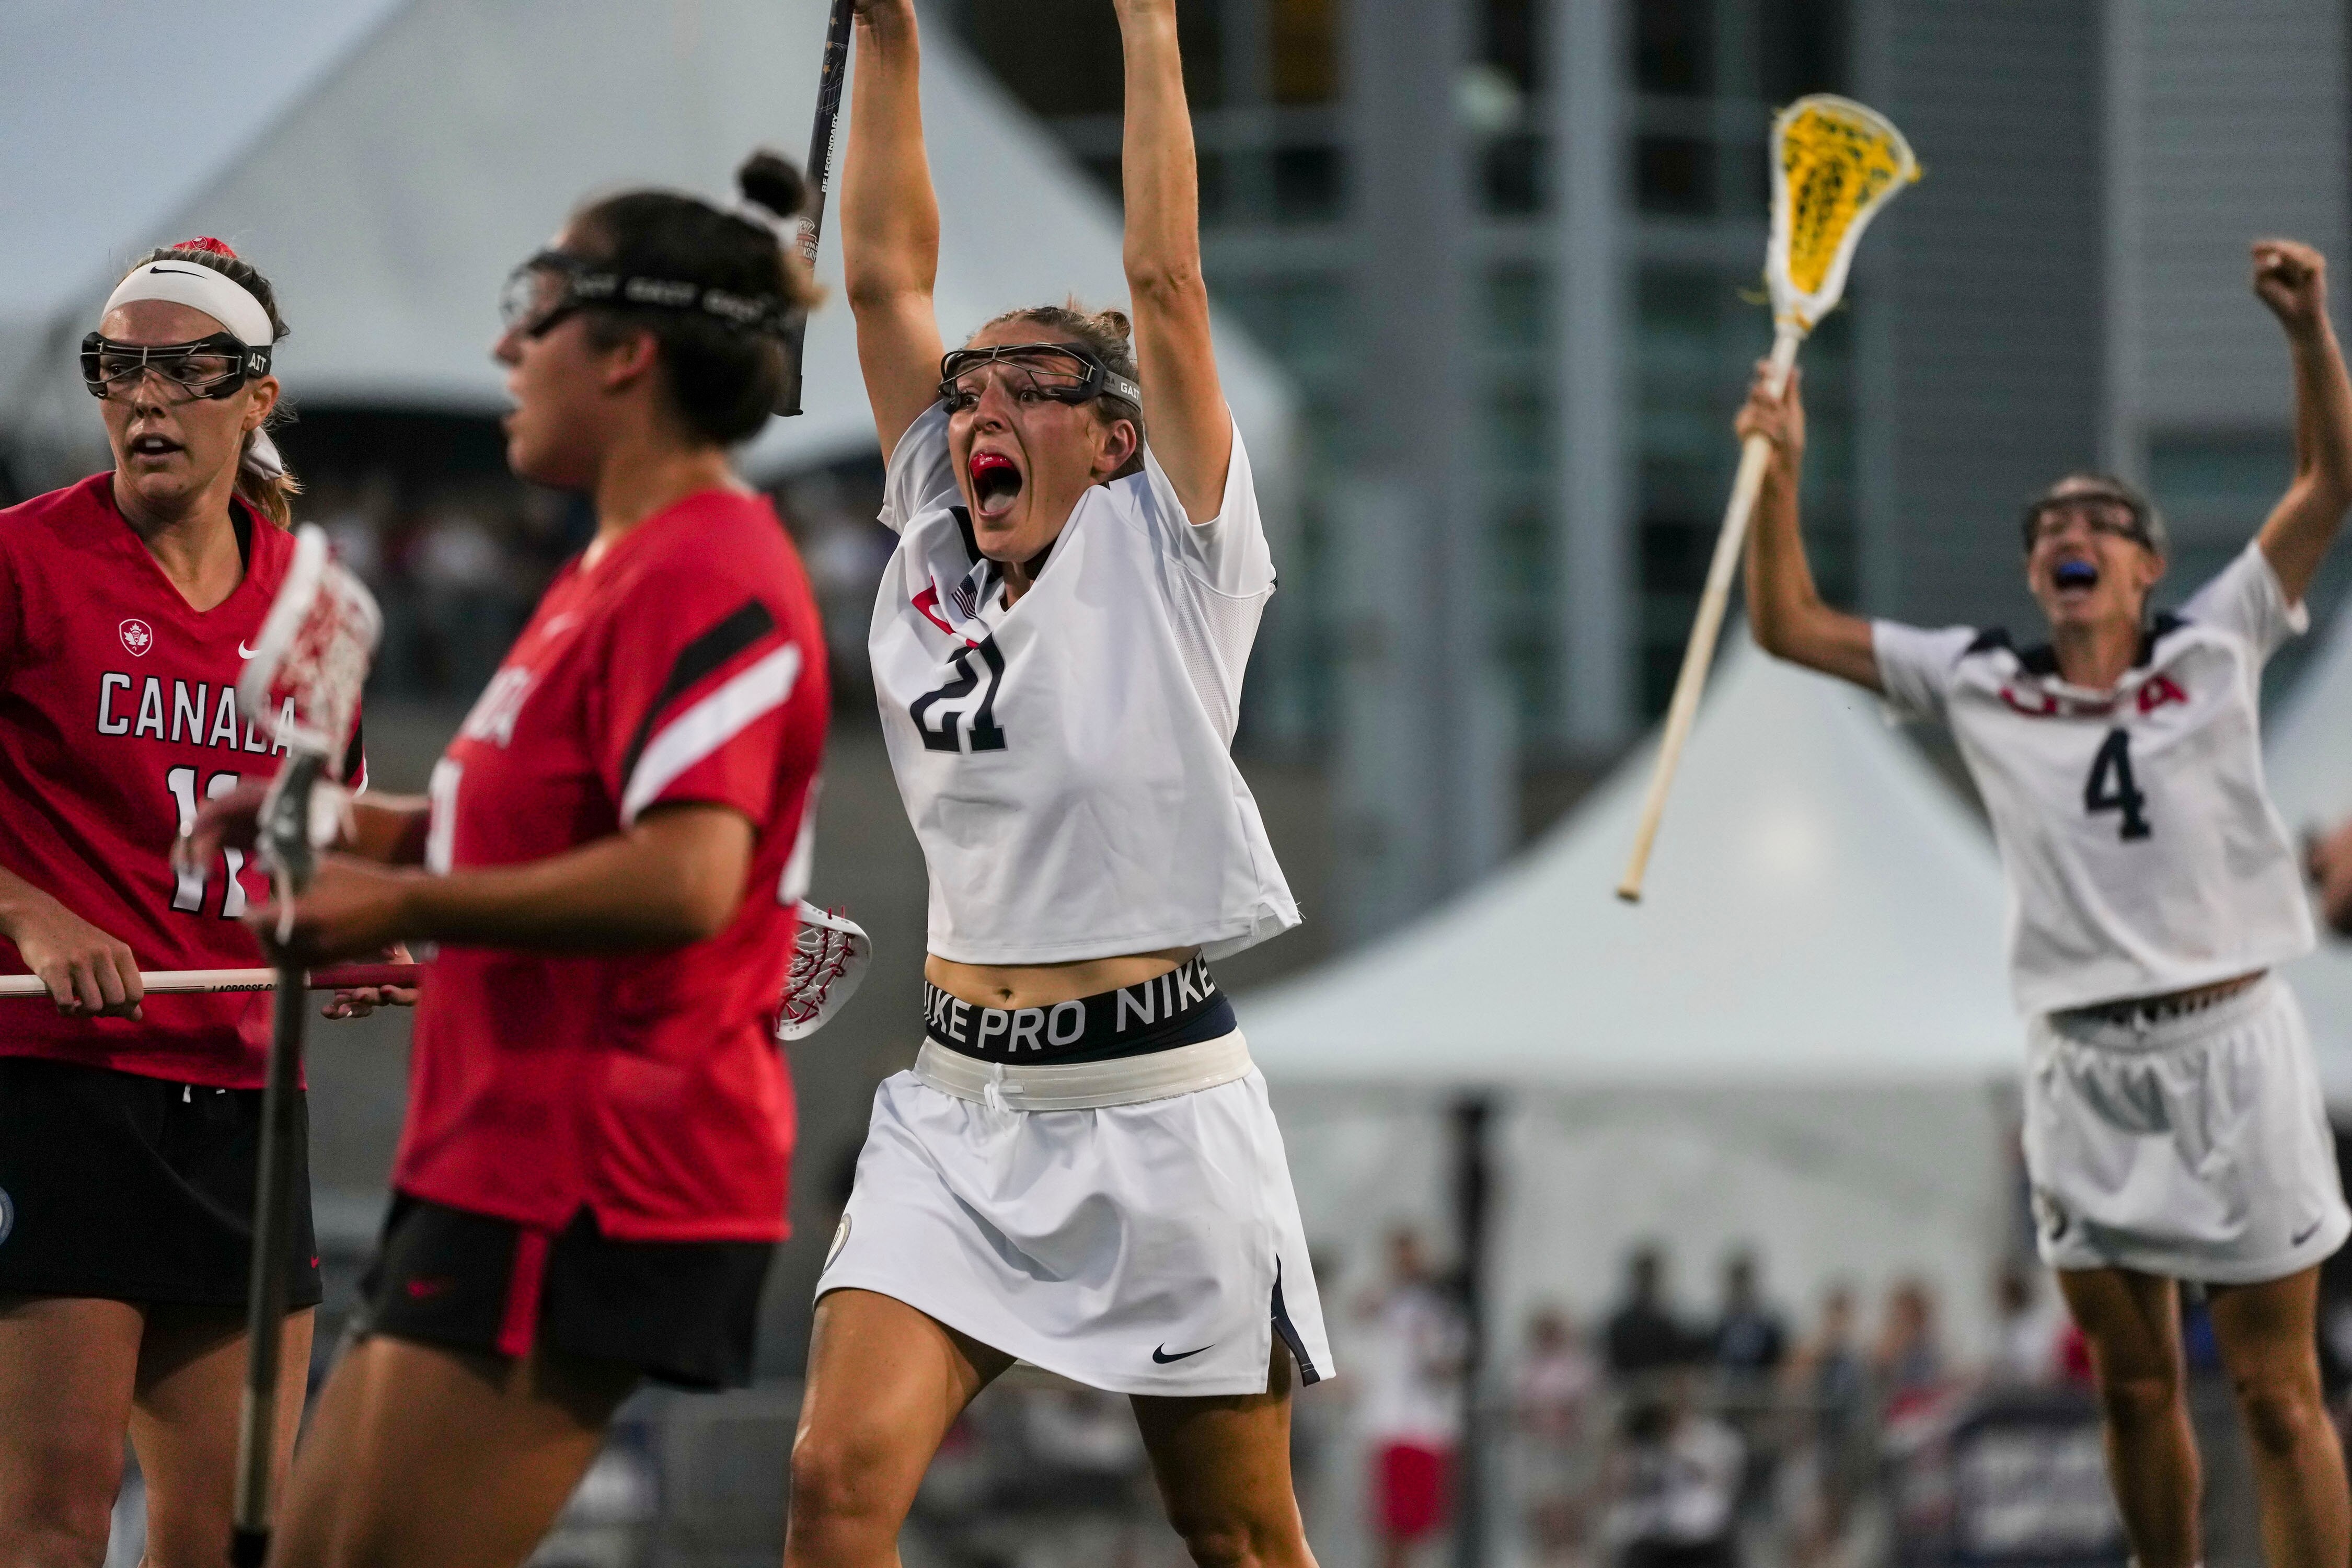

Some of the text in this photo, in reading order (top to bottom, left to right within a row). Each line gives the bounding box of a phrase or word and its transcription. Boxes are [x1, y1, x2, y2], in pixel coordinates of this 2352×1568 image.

[822, 178, 828, 192] BE
[248, 353, 267, 373] AIT
[1121, 382, 1140, 400] GAIT
[909, 631, 1009, 755] 21
[2083, 727, 2152, 843] 4
[977, 1000, 1086, 1053] PRO
[1116, 950, 1216, 1033] NIKE
